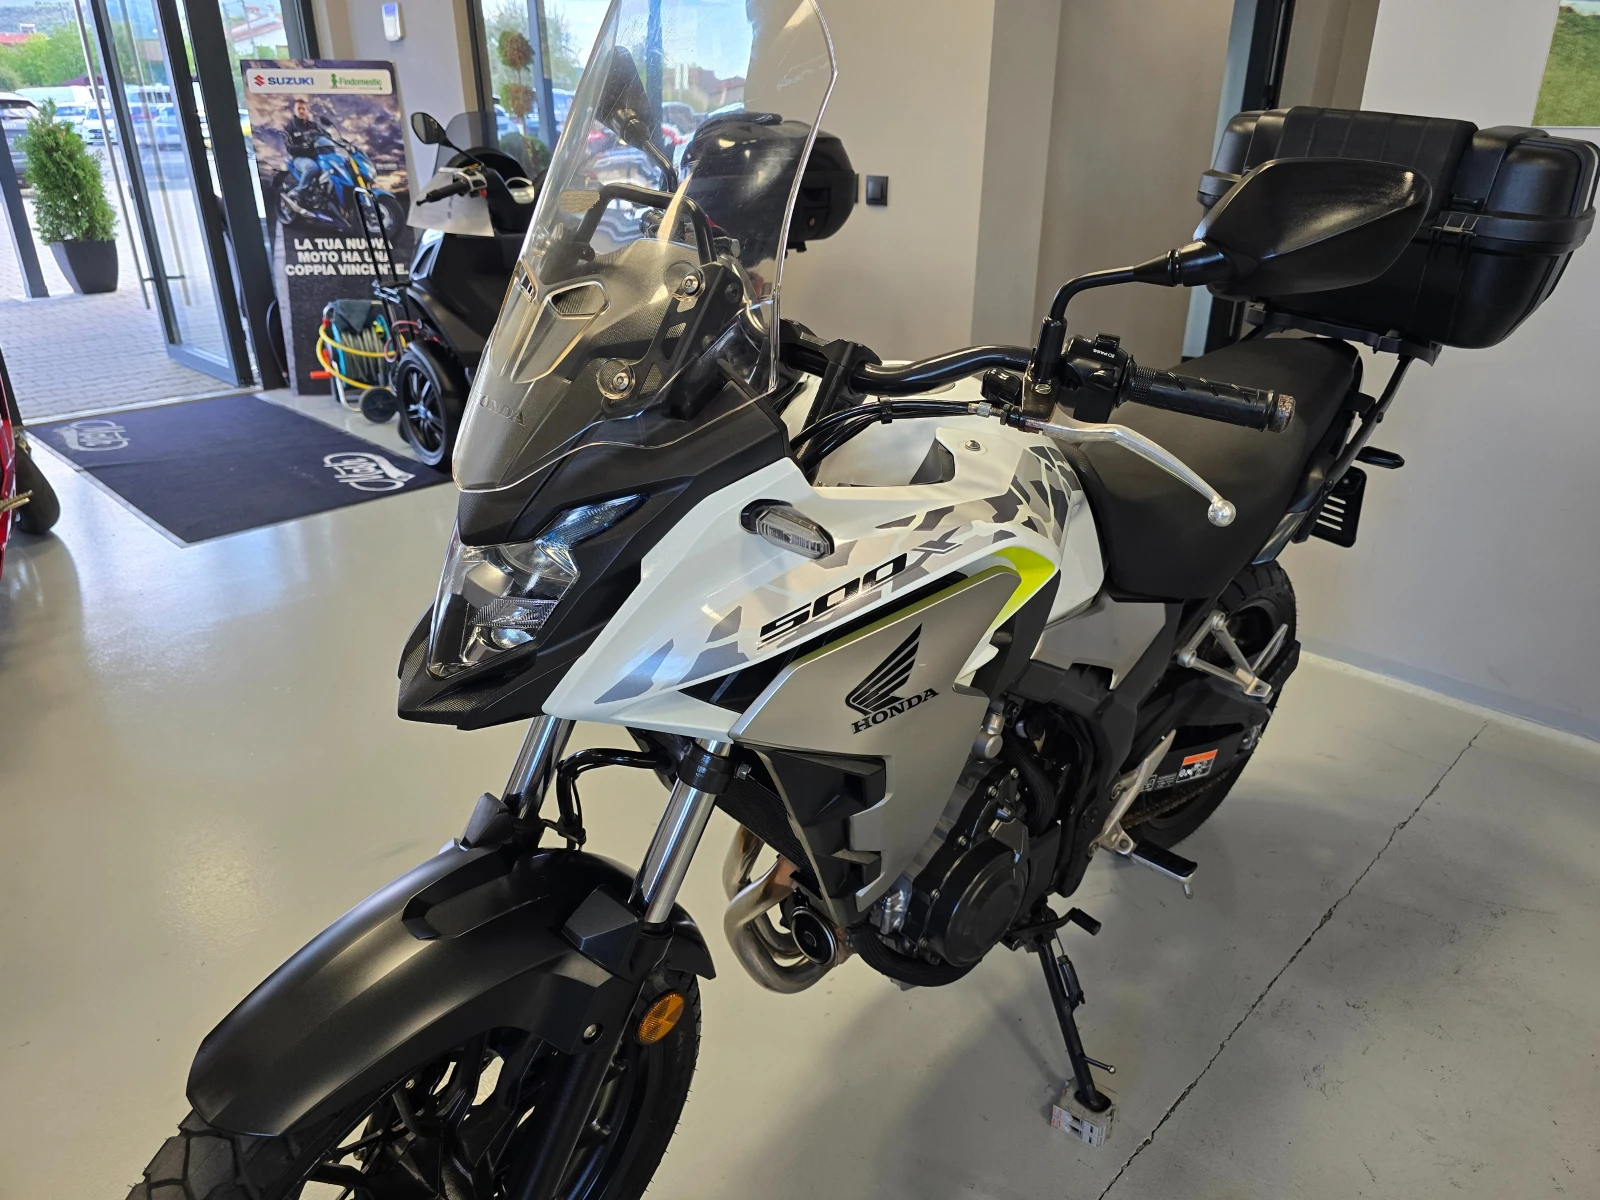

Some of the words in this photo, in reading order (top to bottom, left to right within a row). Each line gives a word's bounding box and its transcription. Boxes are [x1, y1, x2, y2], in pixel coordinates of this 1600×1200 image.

[268, 76, 314, 86] SUZUKI
[339, 77, 382, 87] Findomestic
[294, 238, 313, 250] LA
[315, 238, 344, 250] TUA
[297, 251, 339, 263] MOTO
[341, 251, 362, 263] HA
[285, 263, 337, 276] COPPIA
[757, 553, 907, 646] 500
[911, 526, 963, 569] X
[851, 687, 940, 735] HONDA
